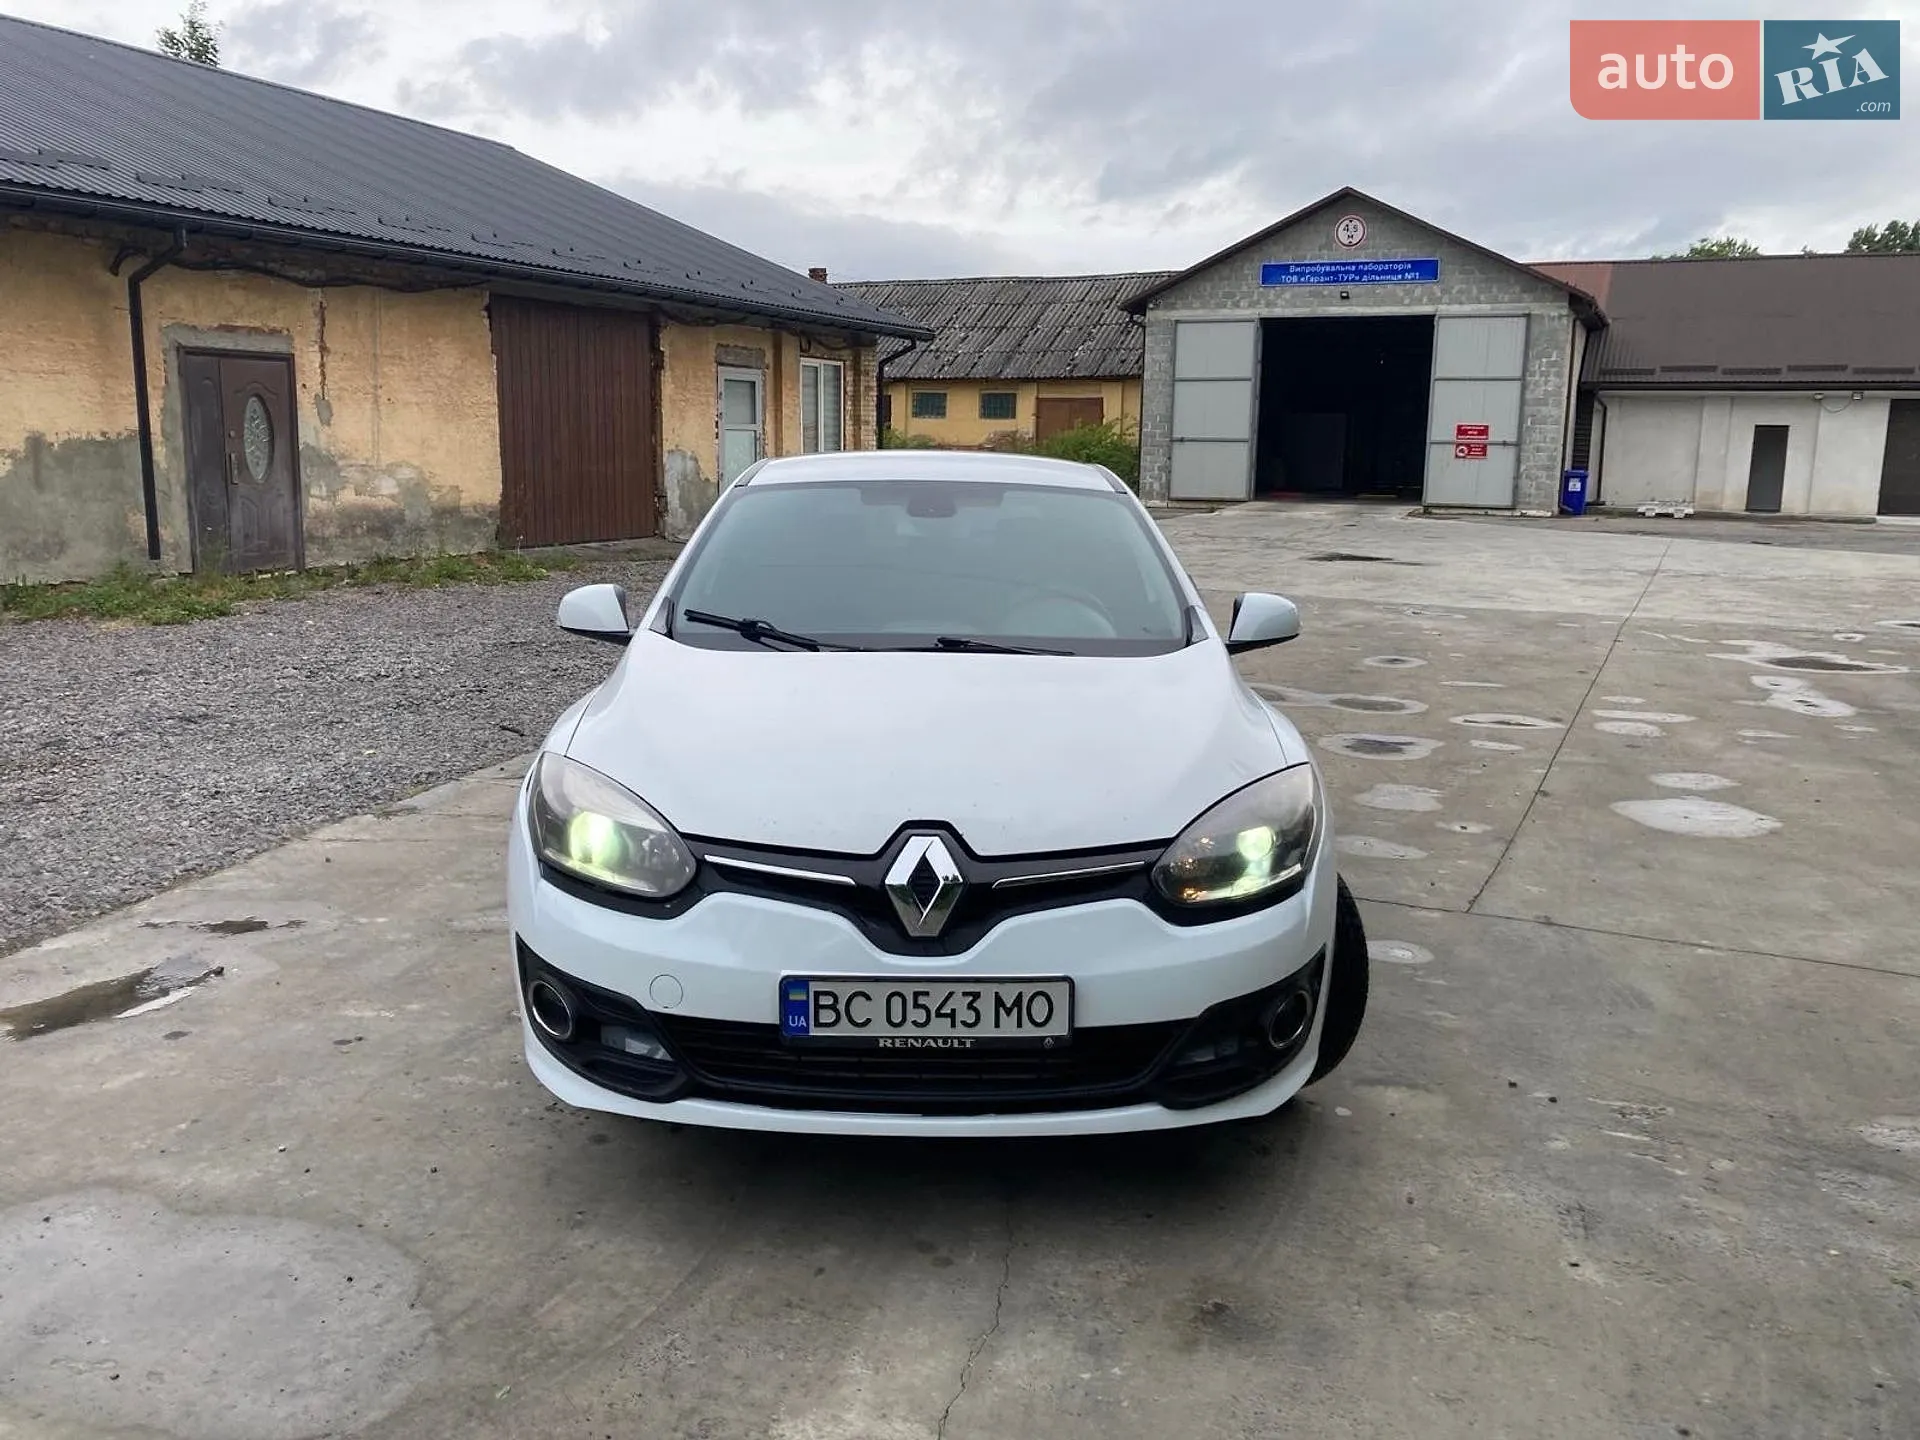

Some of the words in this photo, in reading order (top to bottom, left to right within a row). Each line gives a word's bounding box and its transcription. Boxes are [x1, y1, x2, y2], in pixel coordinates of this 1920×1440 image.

[1289, 263, 1356, 274] Випробувальна
[1358, 262, 1412, 272] лабораторія
[1281, 274, 1298, 283] ТОВ
[1362, 273, 1402, 283] дільниця
[813, 990, 872, 1028] BC
[885, 990, 981, 1028] 0543
[994, 990, 1054, 1029] MO
[789, 1016, 807, 1028] UA
[878, 1038, 976, 1048] RENAULT
